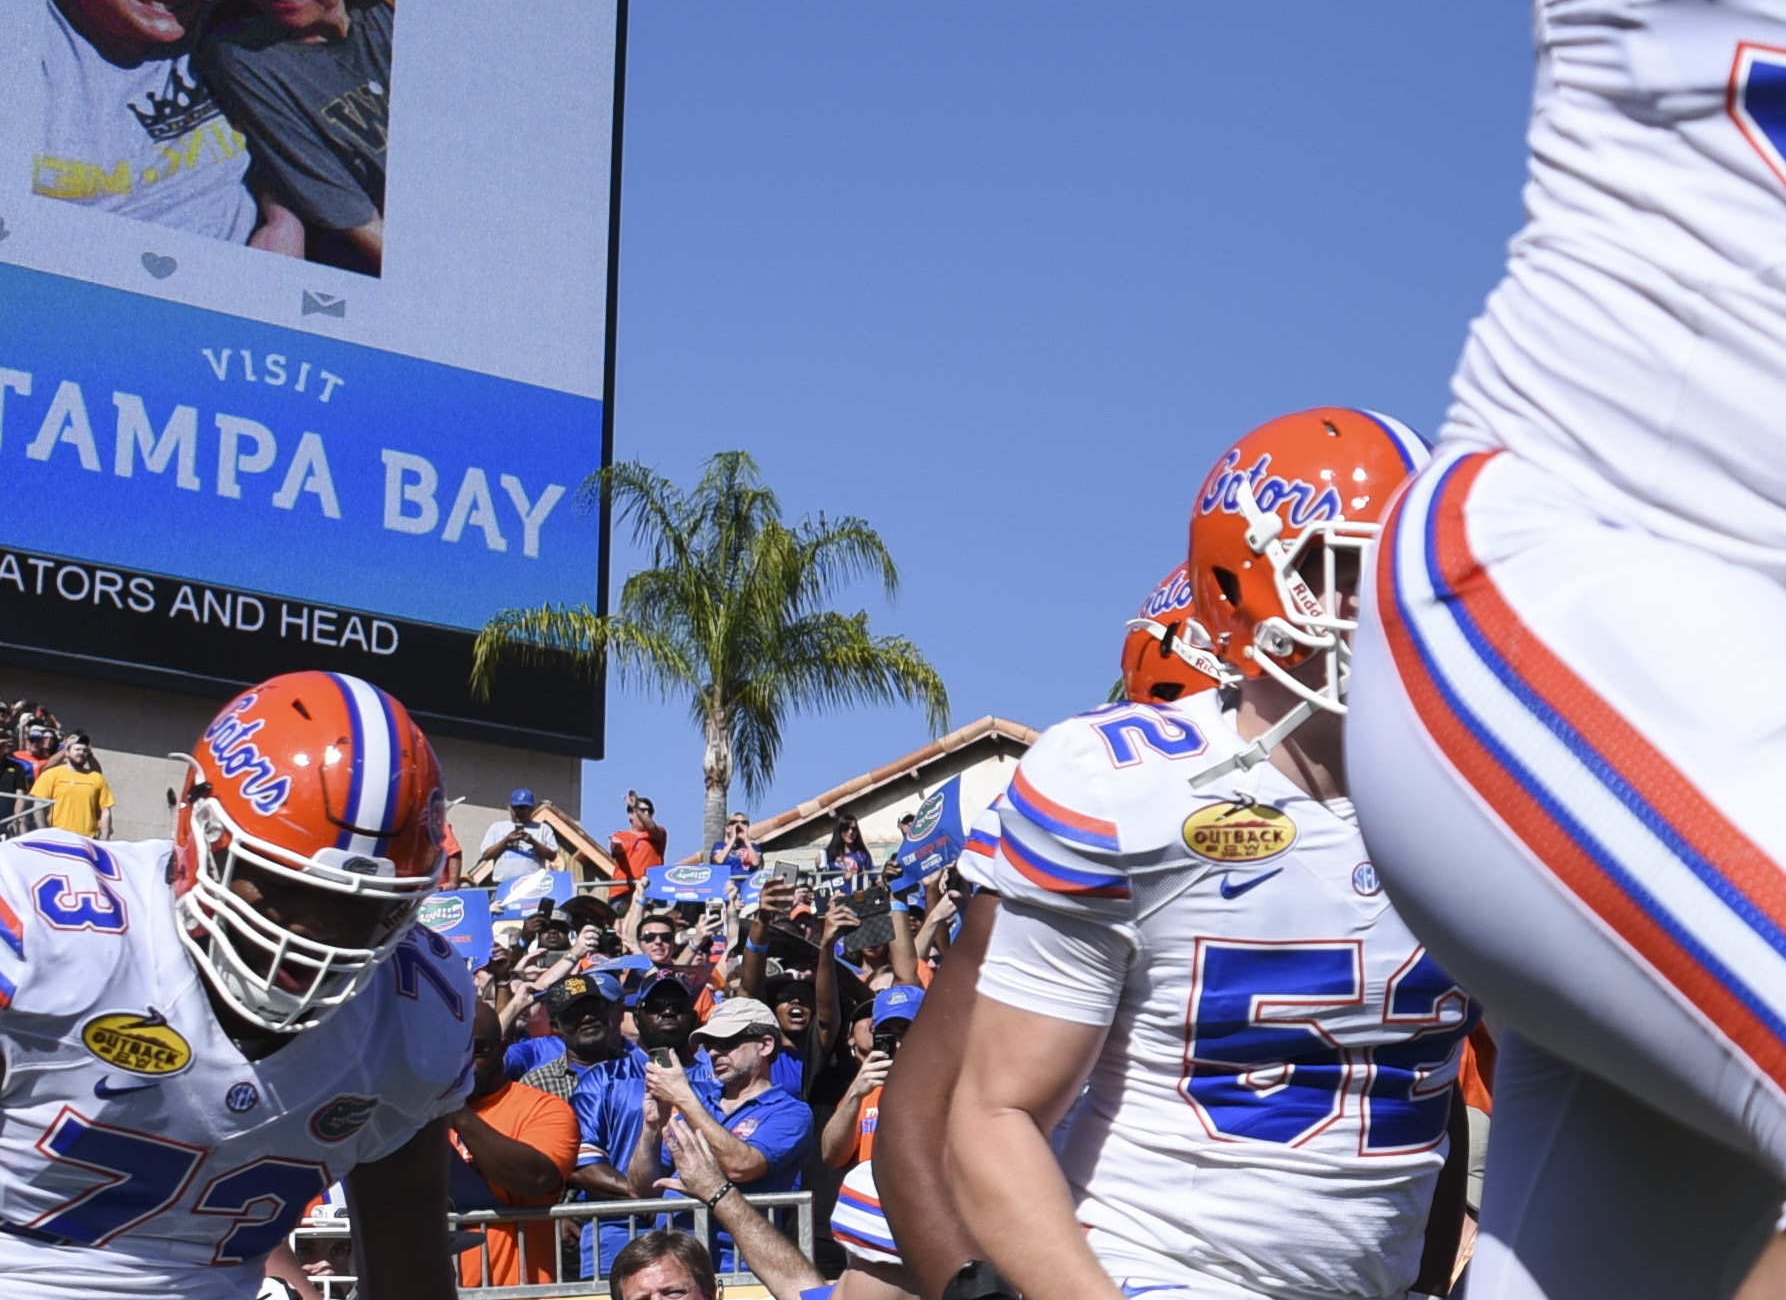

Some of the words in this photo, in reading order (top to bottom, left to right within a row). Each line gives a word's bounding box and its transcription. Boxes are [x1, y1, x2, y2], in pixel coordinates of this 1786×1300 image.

[202, 347, 345, 403] VISIT
[381, 448, 566, 559] BAY
[1201, 448, 1345, 529] Gators
[169, 584, 266, 633] AND
[281, 602, 400, 657] HEAD
[1292, 581, 1329, 636] Ridd
[1193, 829, 1285, 845] OUTBACK
[91, 1030, 179, 1067] OUTBACK
[1177, 935, 1473, 1158] 52
